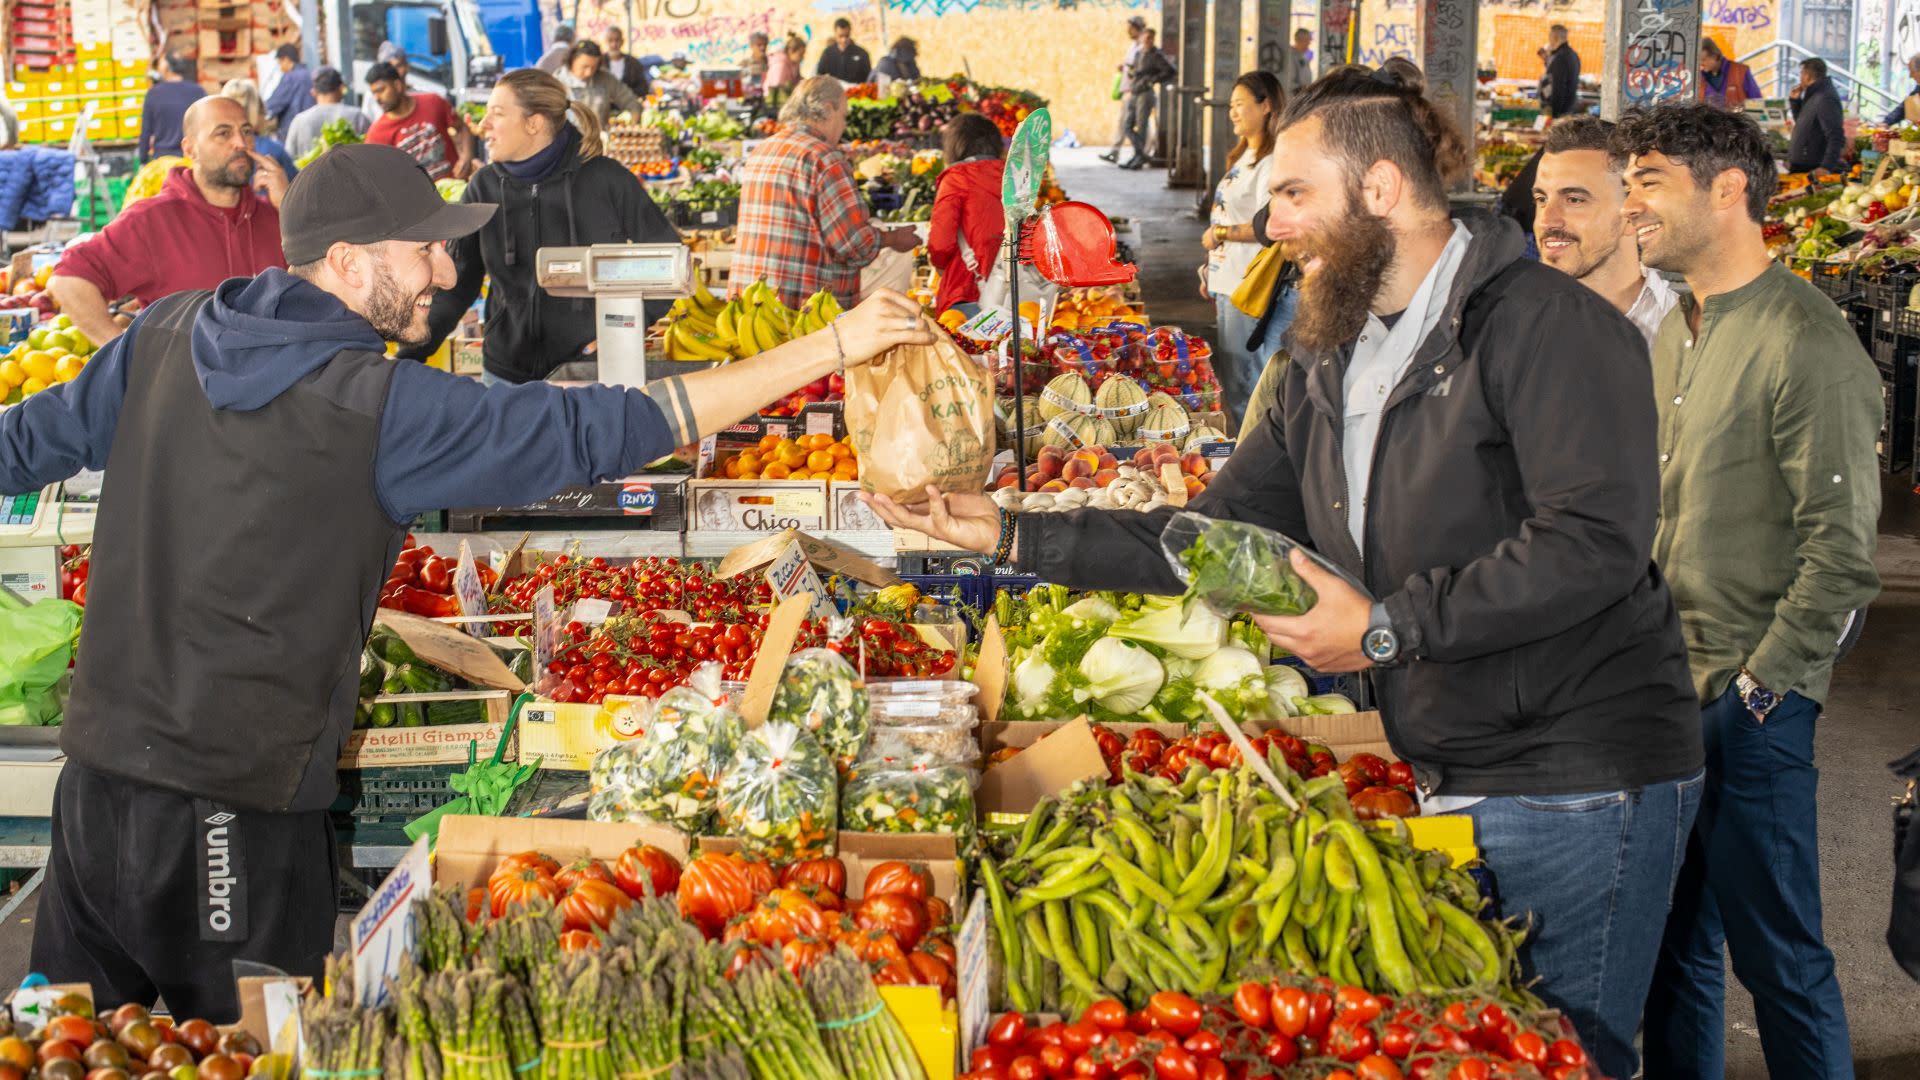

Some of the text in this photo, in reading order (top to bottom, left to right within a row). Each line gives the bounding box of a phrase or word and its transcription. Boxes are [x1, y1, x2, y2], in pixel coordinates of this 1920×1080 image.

[931, 400, 976, 419] KATY
[742, 508, 800, 531] Chico
[206, 827, 237, 932] umbro
